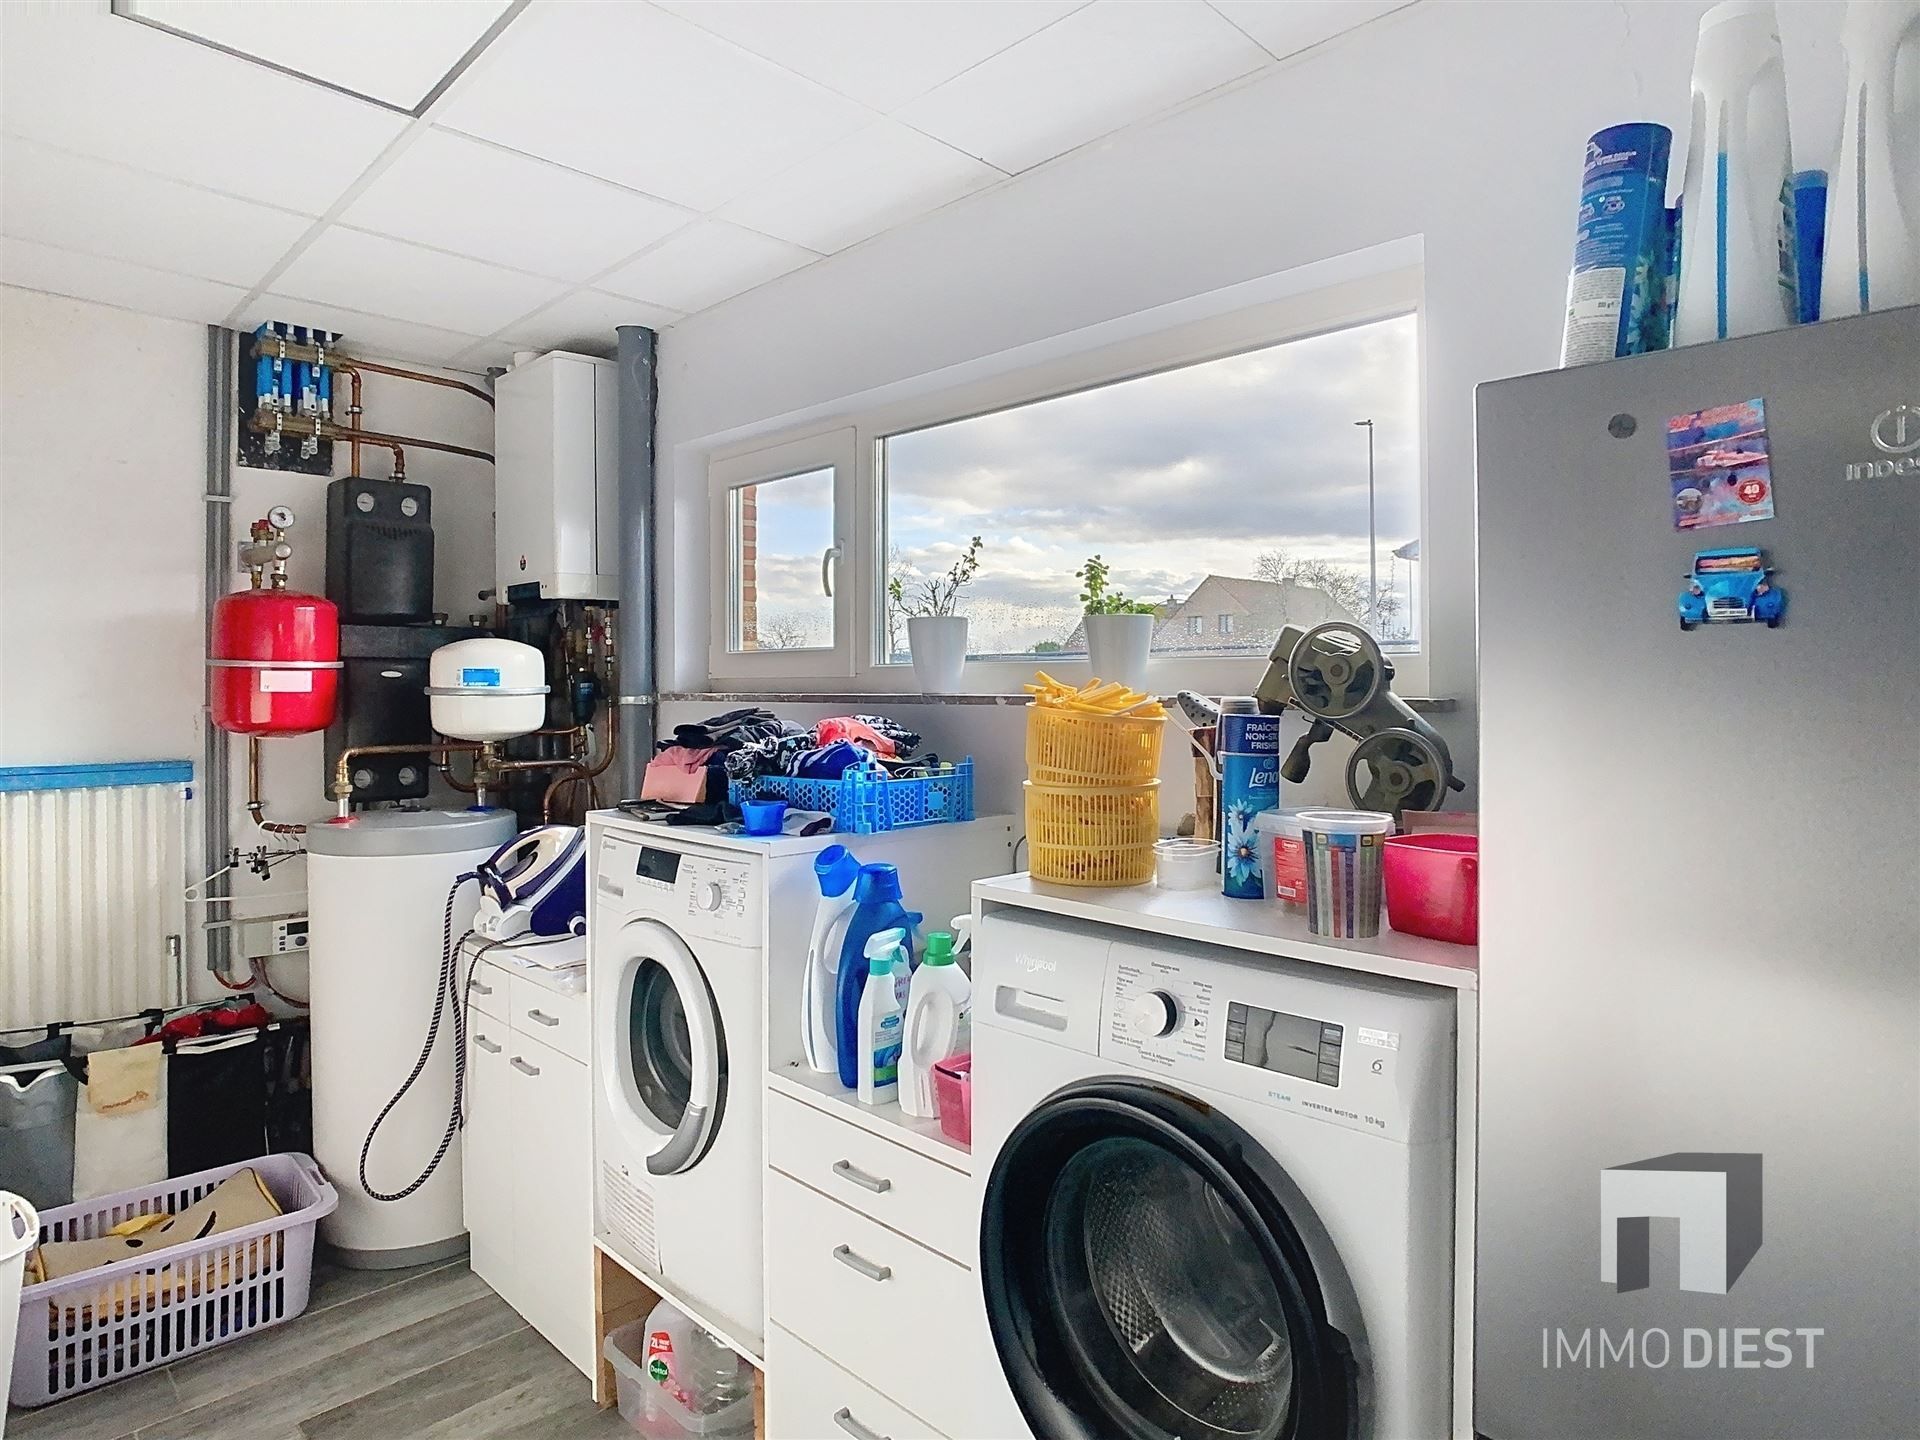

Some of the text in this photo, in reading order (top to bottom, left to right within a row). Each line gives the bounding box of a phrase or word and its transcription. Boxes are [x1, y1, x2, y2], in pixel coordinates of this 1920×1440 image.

[1302, 1101, 1358, 1120] INVERTER MOTOR
[1365, 1116, 1385, 1129] 10 kg
